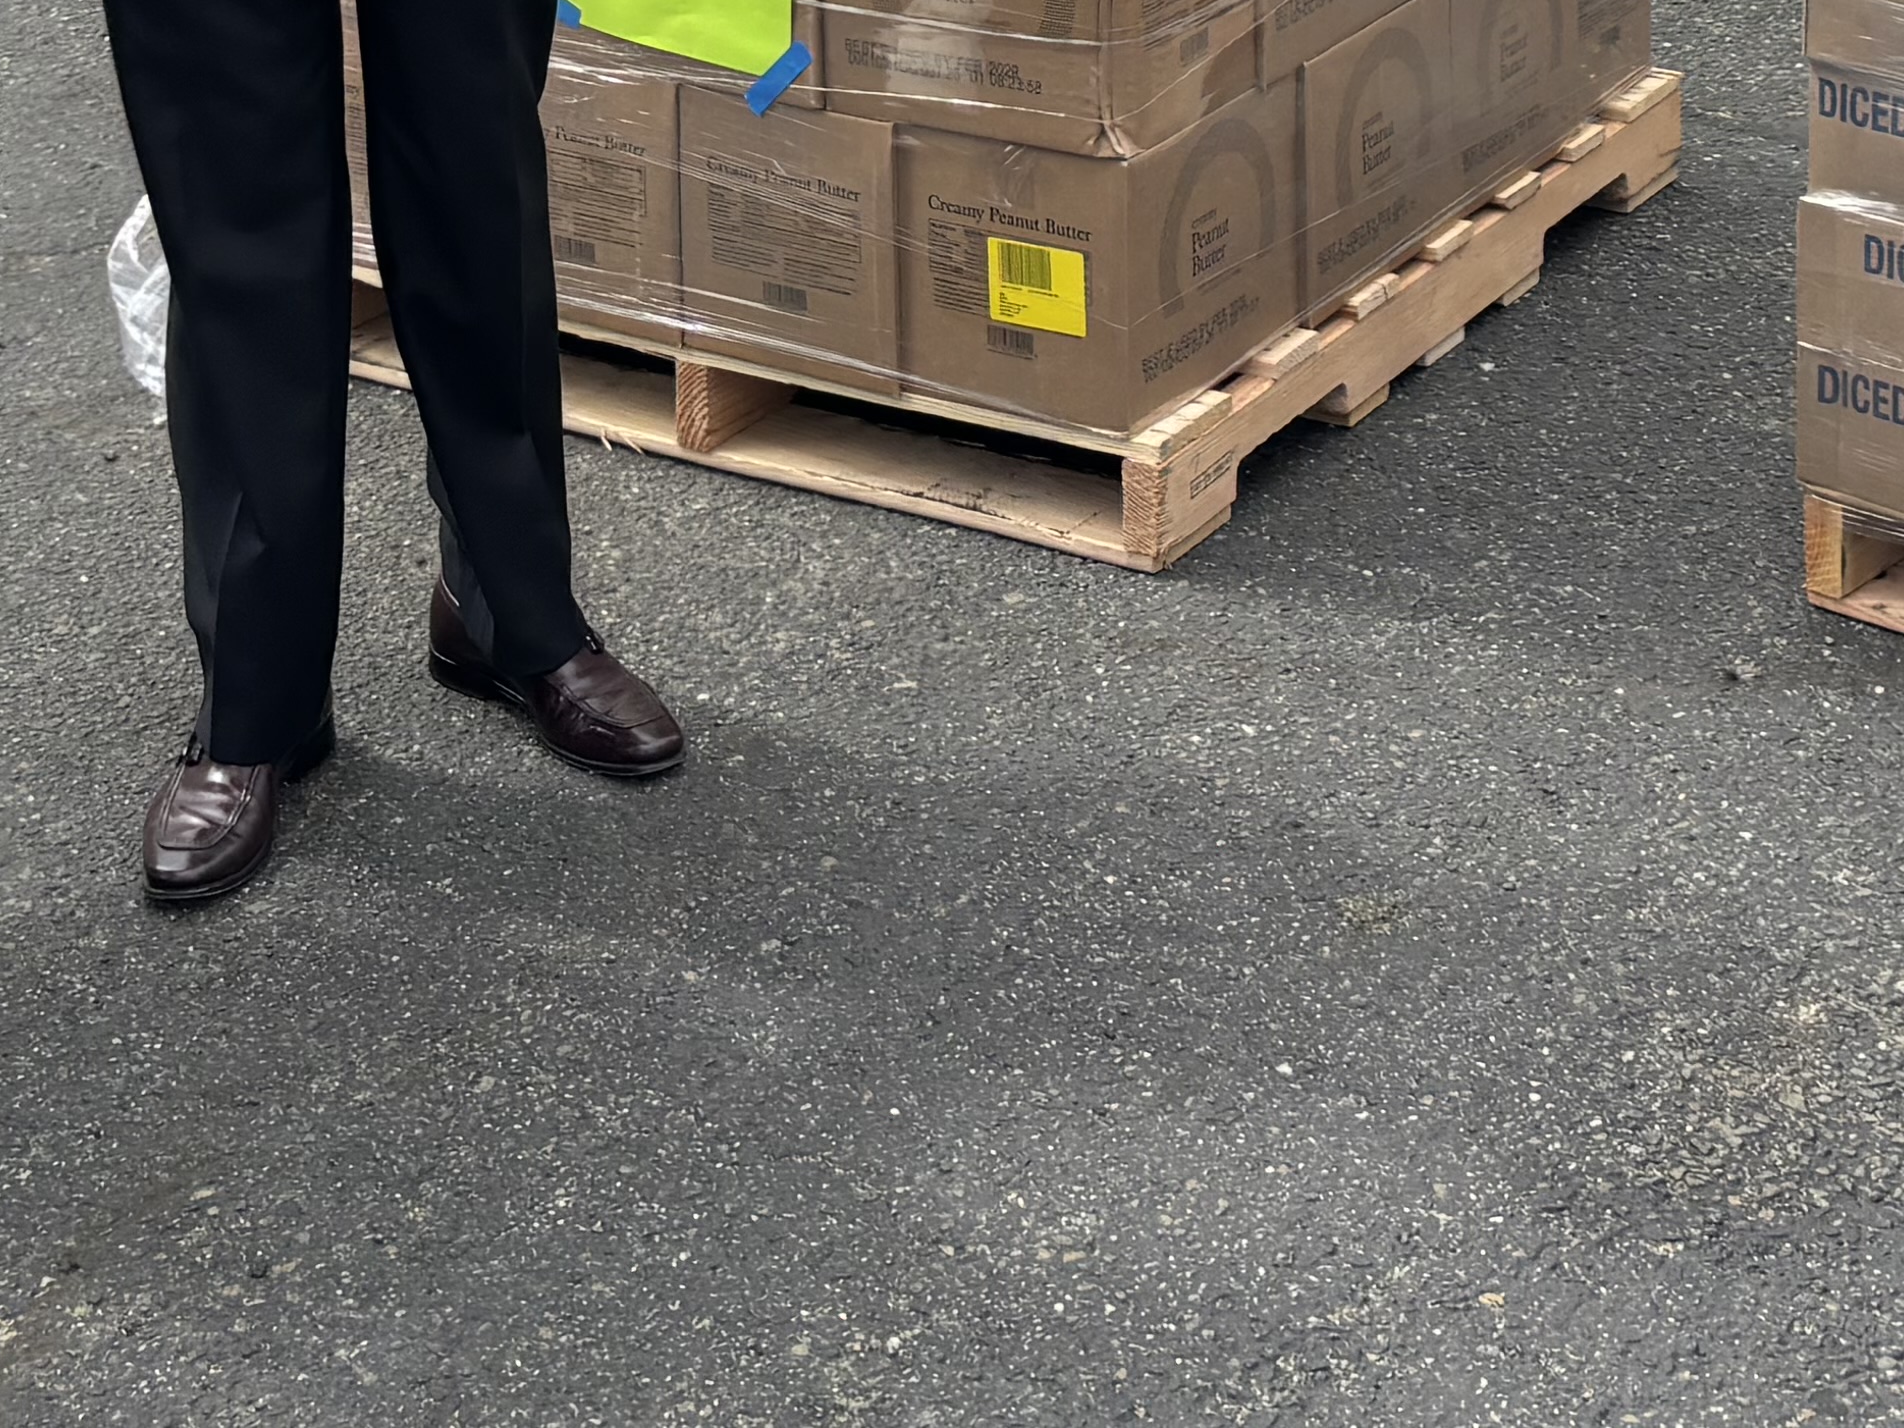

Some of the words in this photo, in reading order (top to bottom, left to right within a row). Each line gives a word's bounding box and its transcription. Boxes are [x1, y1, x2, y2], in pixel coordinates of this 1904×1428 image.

[816, 177, 862, 203] Butter
[928, 193, 985, 225] Creamy
[989, 205, 1041, 232] Peanut
[1045, 217, 1094, 243] Butter
[1192, 217, 1230, 255] Peanut
[1192, 243, 1227, 277] Butter
